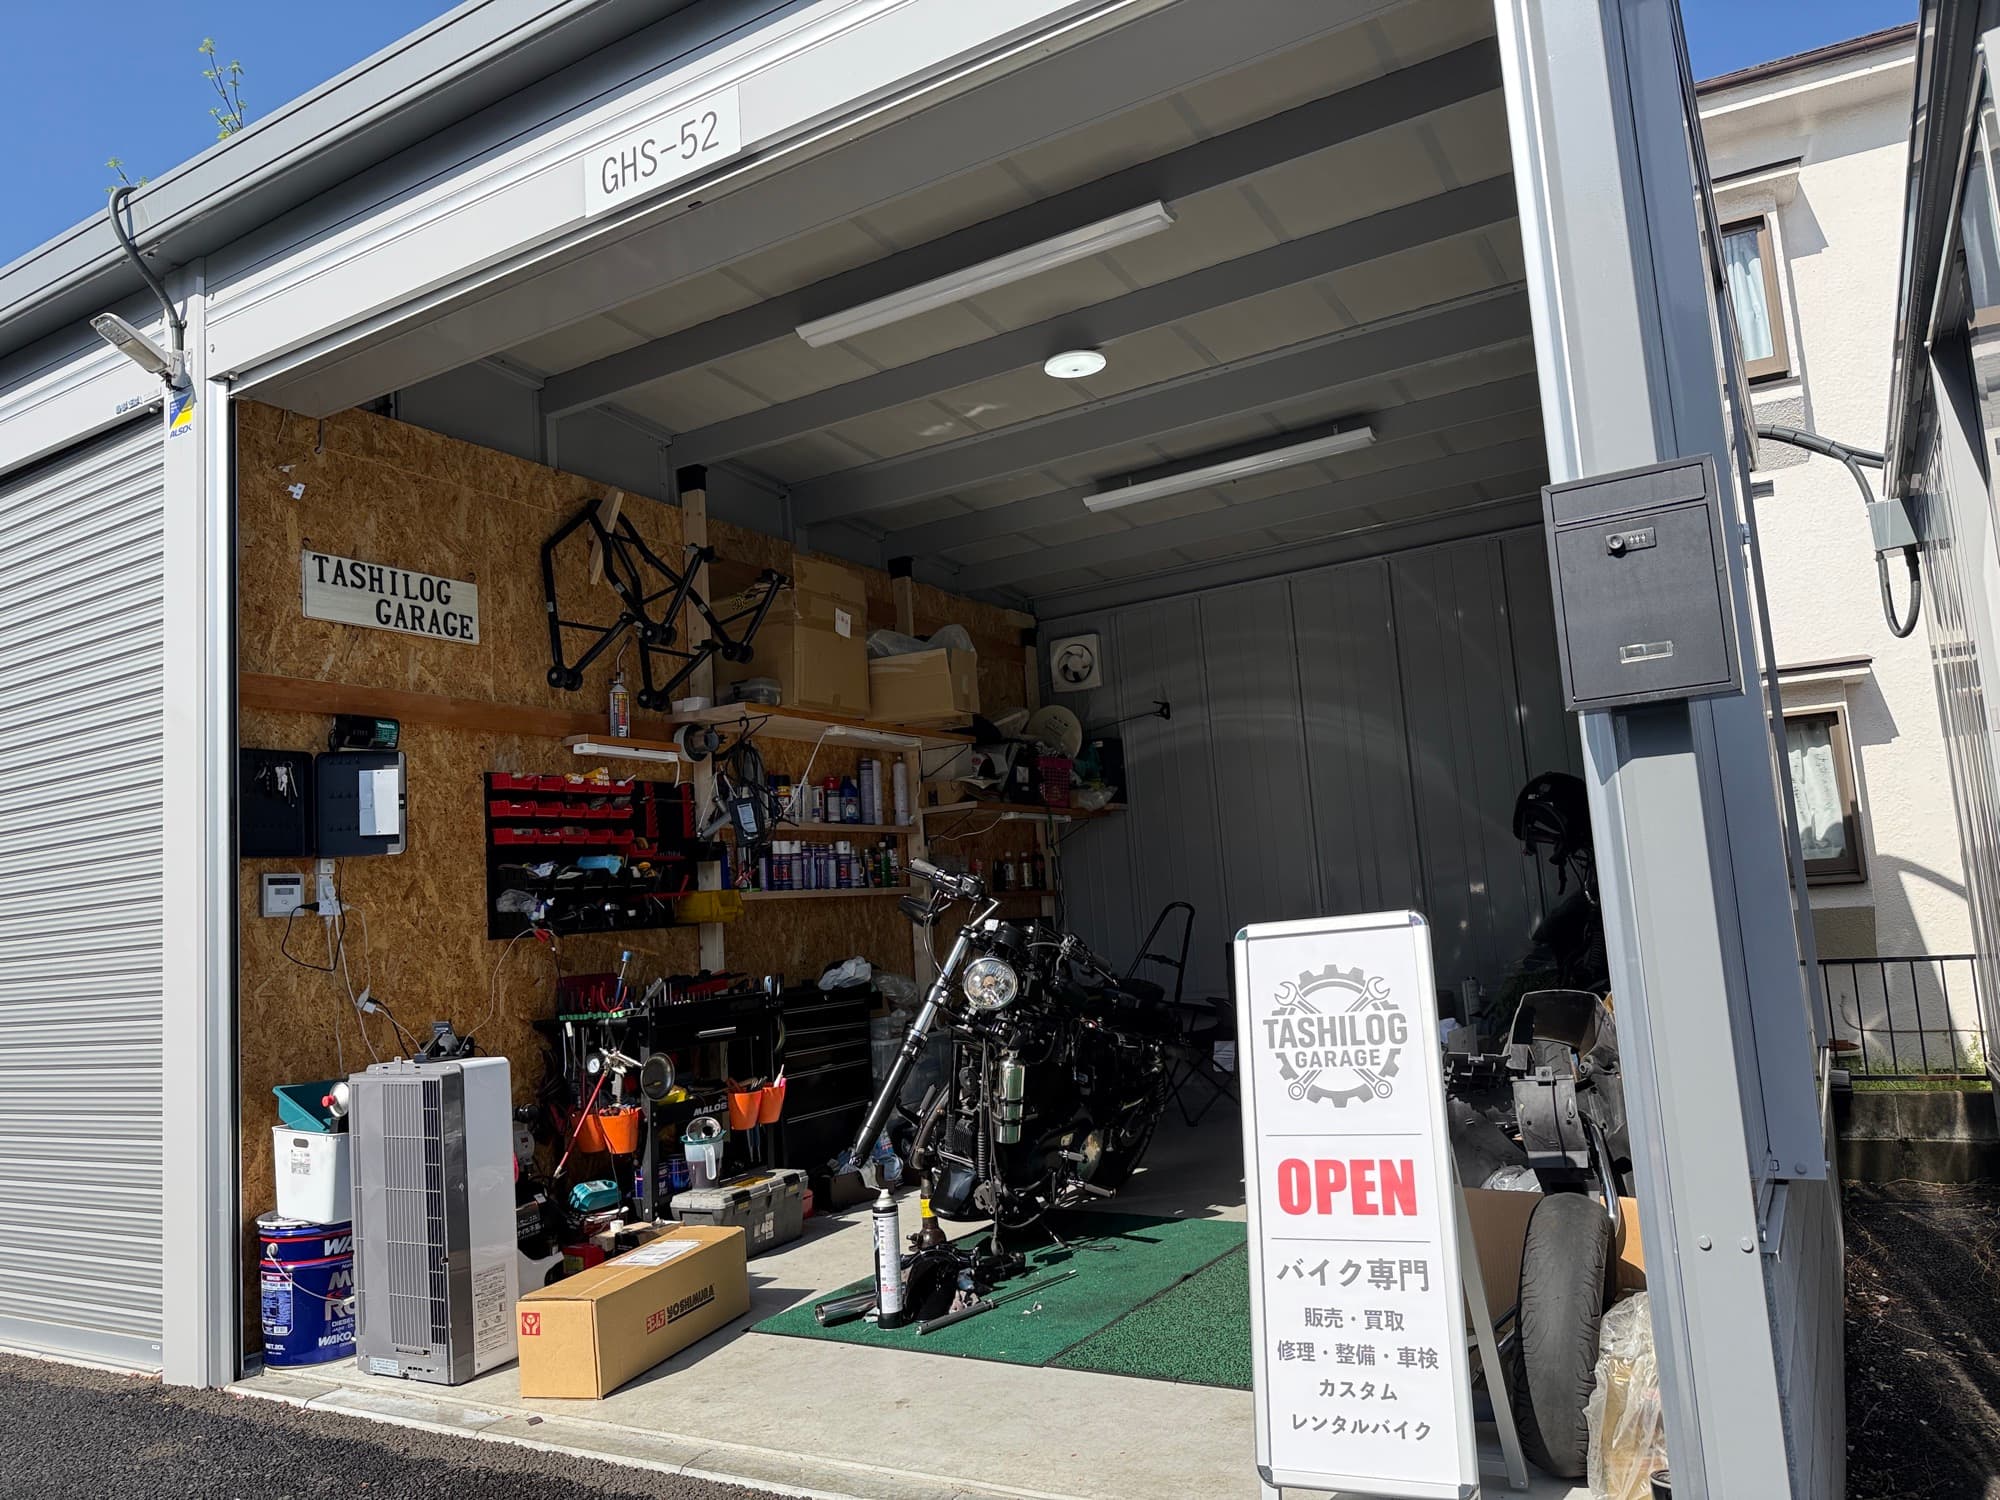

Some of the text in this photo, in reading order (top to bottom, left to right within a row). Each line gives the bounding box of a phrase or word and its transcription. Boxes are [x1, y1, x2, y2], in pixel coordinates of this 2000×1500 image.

[605, 112, 719, 194] GHS-52
[312, 554, 452, 606] TASHILOG
[375, 597, 474, 641] GARAGE
[1262, 1012, 1408, 1049] TASHILOG
[1295, 1049, 1382, 1068] GARAGE
[1277, 1158, 1418, 1216] OPEN
[1277, 1257, 1430, 1292] バイク専門
[666, 1284, 715, 1320] YOSHIMURA
[1304, 1307, 1405, 1332] 販売・買取
[1277, 1339, 1440, 1369] 修理・整備・車検
[1319, 1379, 1398, 1401] カスタム
[1291, 1412, 1432, 1441] レンタルバイク
